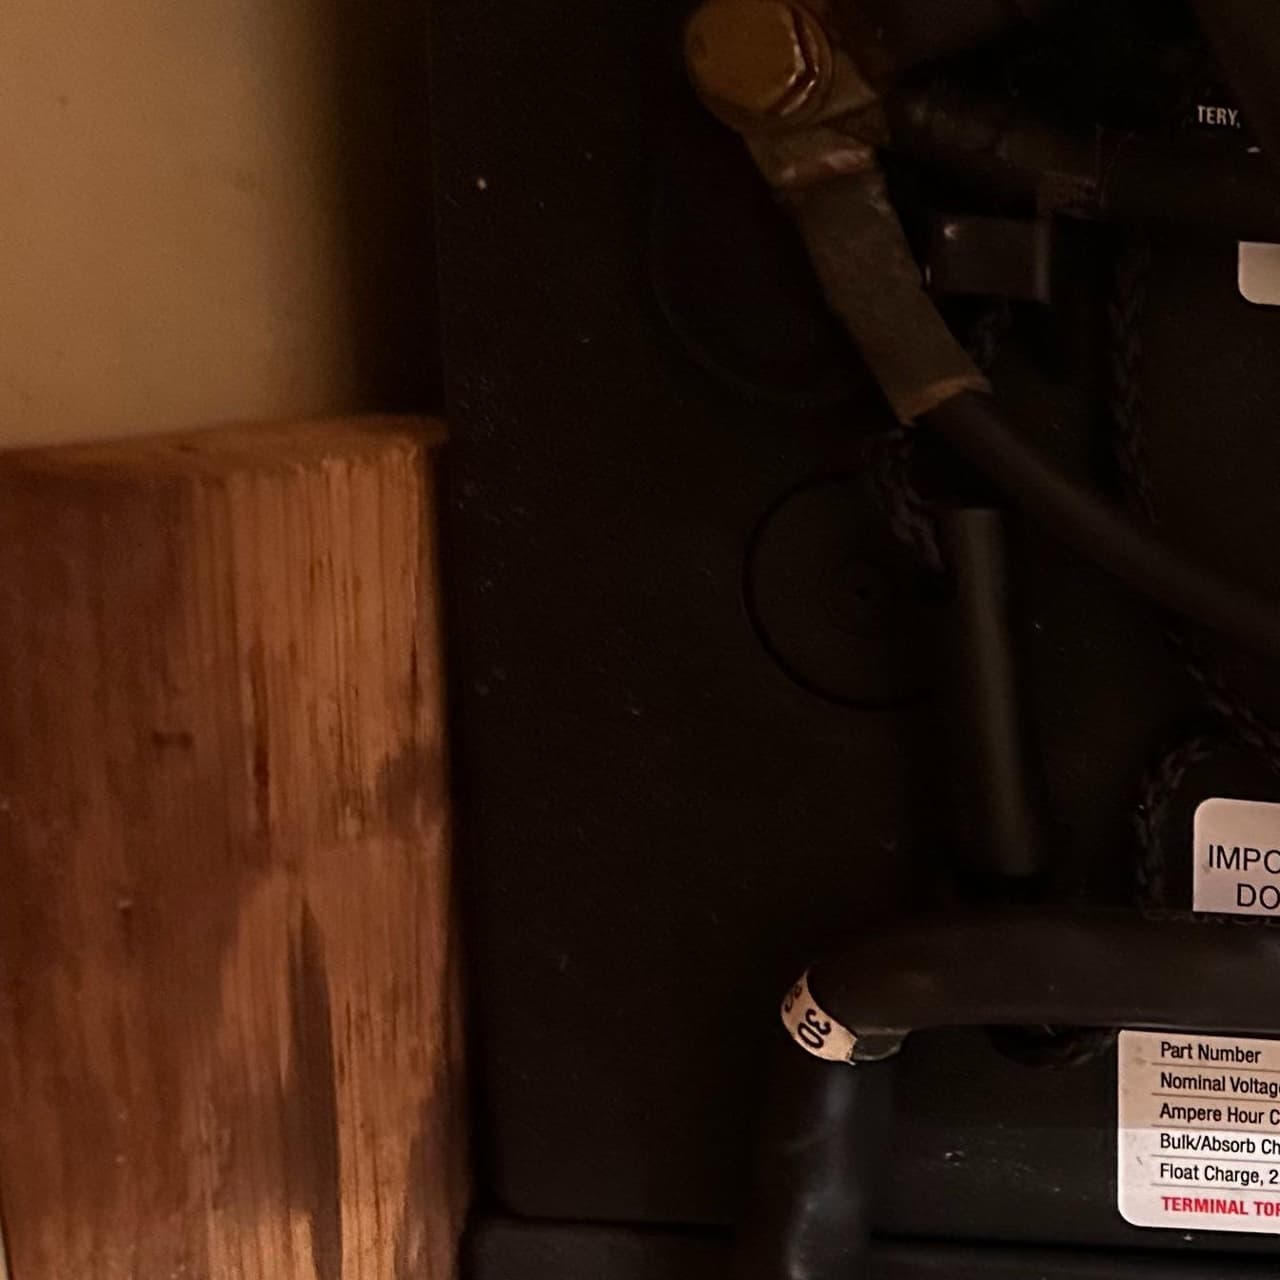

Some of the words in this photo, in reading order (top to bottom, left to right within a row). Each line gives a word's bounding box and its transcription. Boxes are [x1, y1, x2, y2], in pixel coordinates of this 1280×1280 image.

[1196, 104, 1241, 130] TERY,
[1160, 1041, 1193, 1060] Part
[1197, 1044, 1261, 1064] Number
[1160, 1072, 1225, 1092] Nominal
[1159, 1102, 1222, 1122] Ampere
[1226, 1106, 1264, 1124] Hour
[1159, 1132, 1255, 1154] Bulk/Absorb
[1159, 1162, 1199, 1181] Float
[1203, 1165, 1264, 1186] Charge,
[1161, 1196, 1248, 1215] TERMINAL
